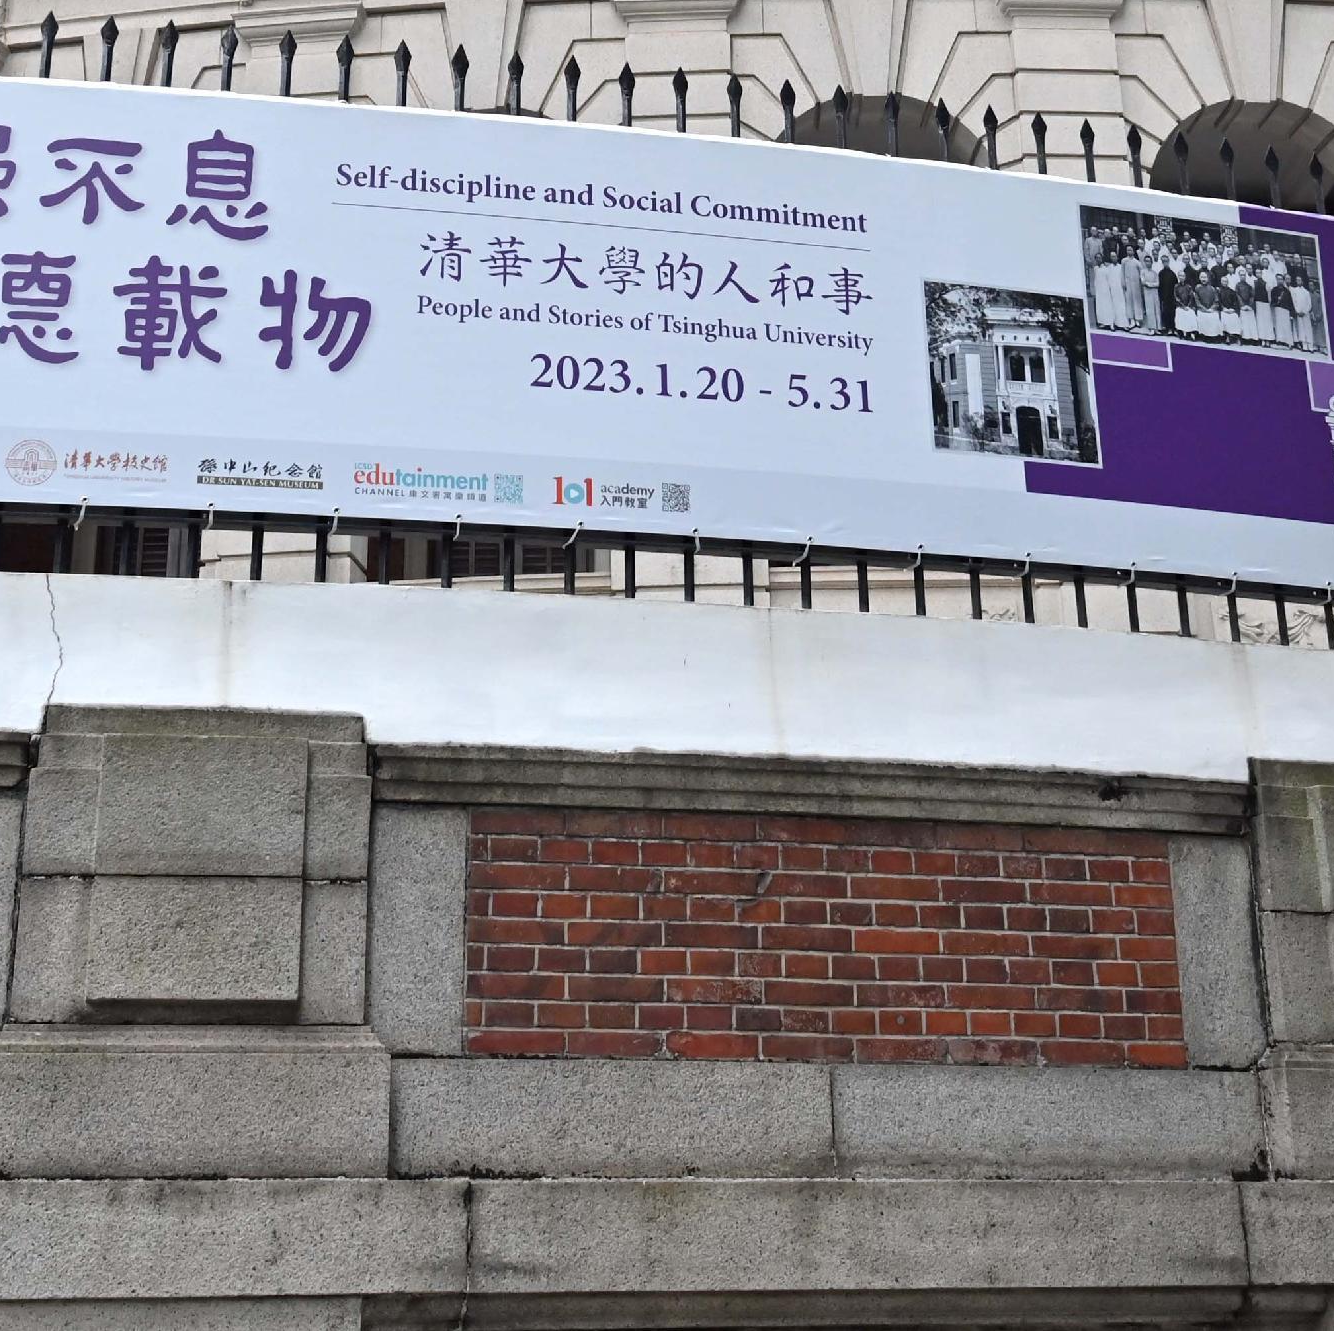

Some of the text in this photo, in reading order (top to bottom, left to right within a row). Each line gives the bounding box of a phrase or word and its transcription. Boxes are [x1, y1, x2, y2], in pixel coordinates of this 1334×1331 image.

[336, 163, 868, 233] Self-discipline and Social Commitment
[418, 230, 874, 315] 清華大學的人和事
[417, 295, 874, 356] People and Stories of Tsinghua University
[530, 353, 744, 402] 2023.1.20
[787, 373, 874, 413] 5.31
[202, 476, 319, 489] DR SUN YAT-SEN MUSEUM
[354, 463, 489, 491] edutainment
[600, 483, 655, 499] academy
[354, 487, 405, 497] CHANNEL
[600, 495, 647, 509] 入門教室
